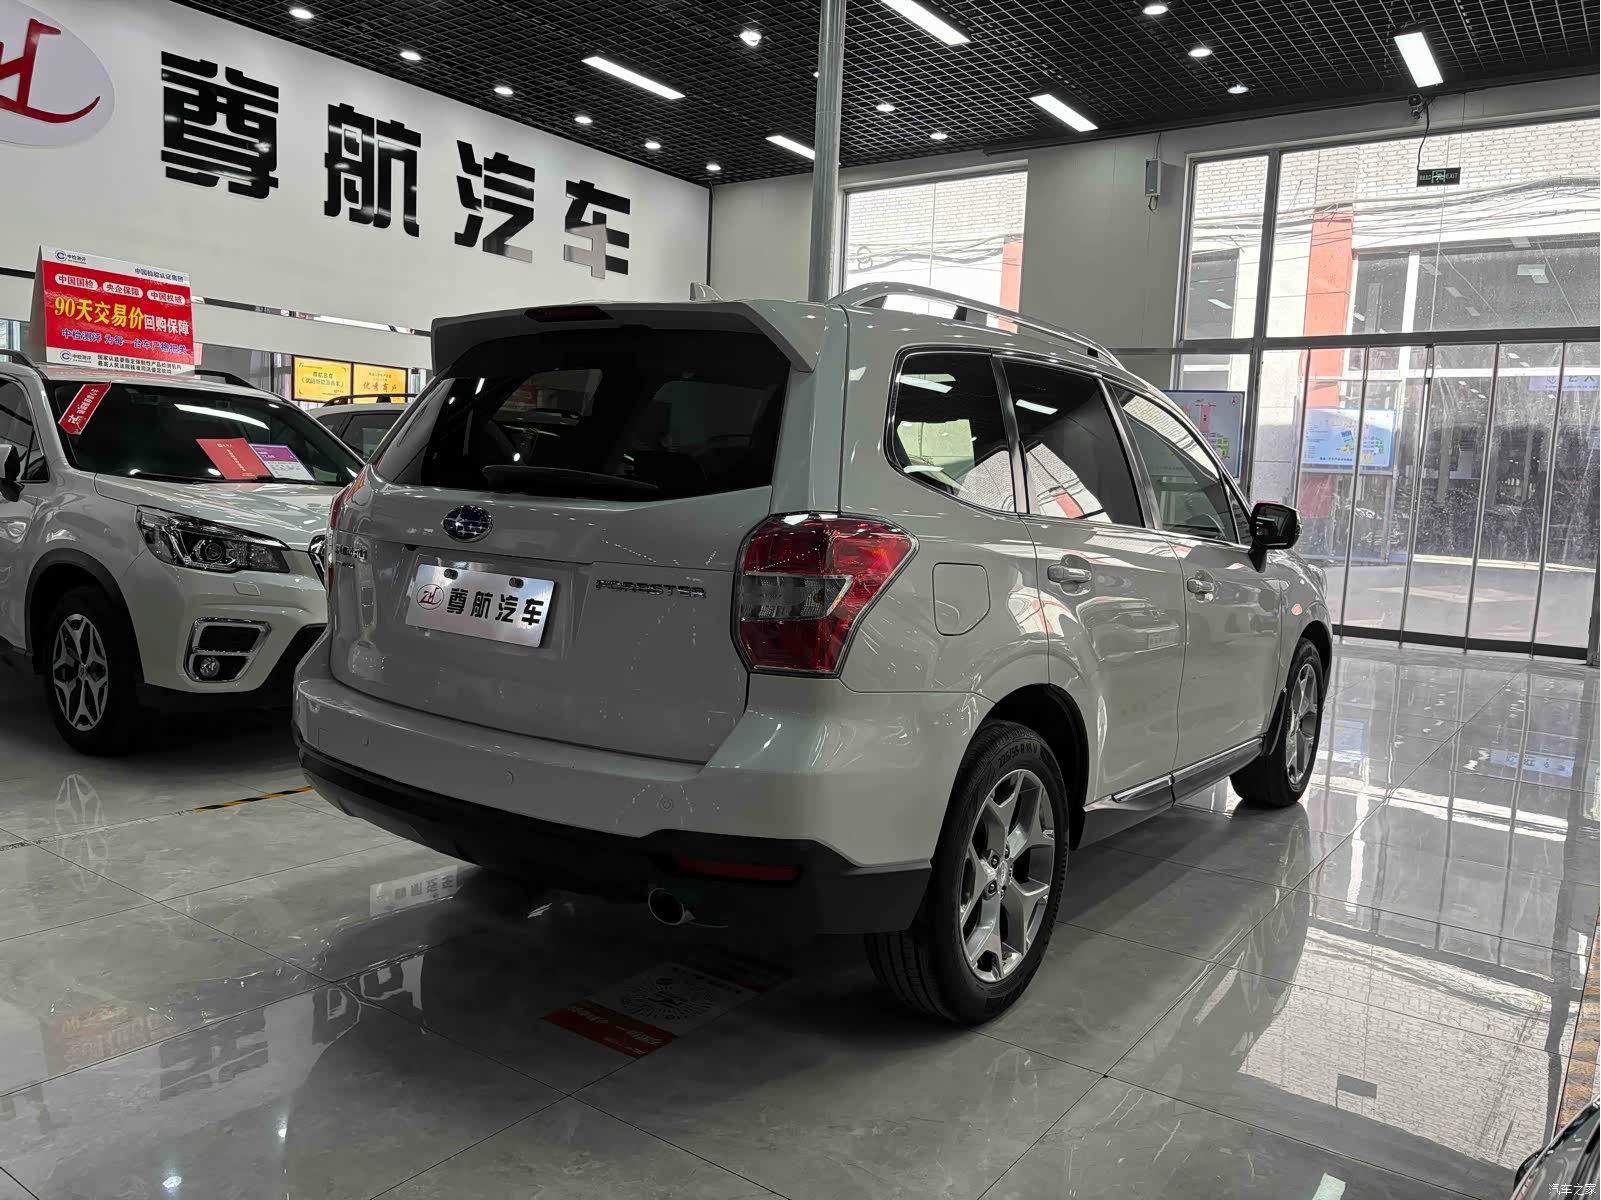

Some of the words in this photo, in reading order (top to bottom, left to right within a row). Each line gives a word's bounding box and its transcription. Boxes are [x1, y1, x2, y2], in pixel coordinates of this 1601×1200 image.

[160, 50, 631, 280] 尊航汽车
[135, 267, 184, 282] 中国检验认证集团
[58, 274, 94, 289] 中国国检
[106, 283, 141, 297] 央企保障
[150, 291, 183, 305] 中国权威
[61, 328, 102, 343] 中检测评
[105, 335, 187, 354] 为每一台车严格把关
[596, 579, 706, 599] FORESTER
[446, 588, 545, 626] 尊航汽车
